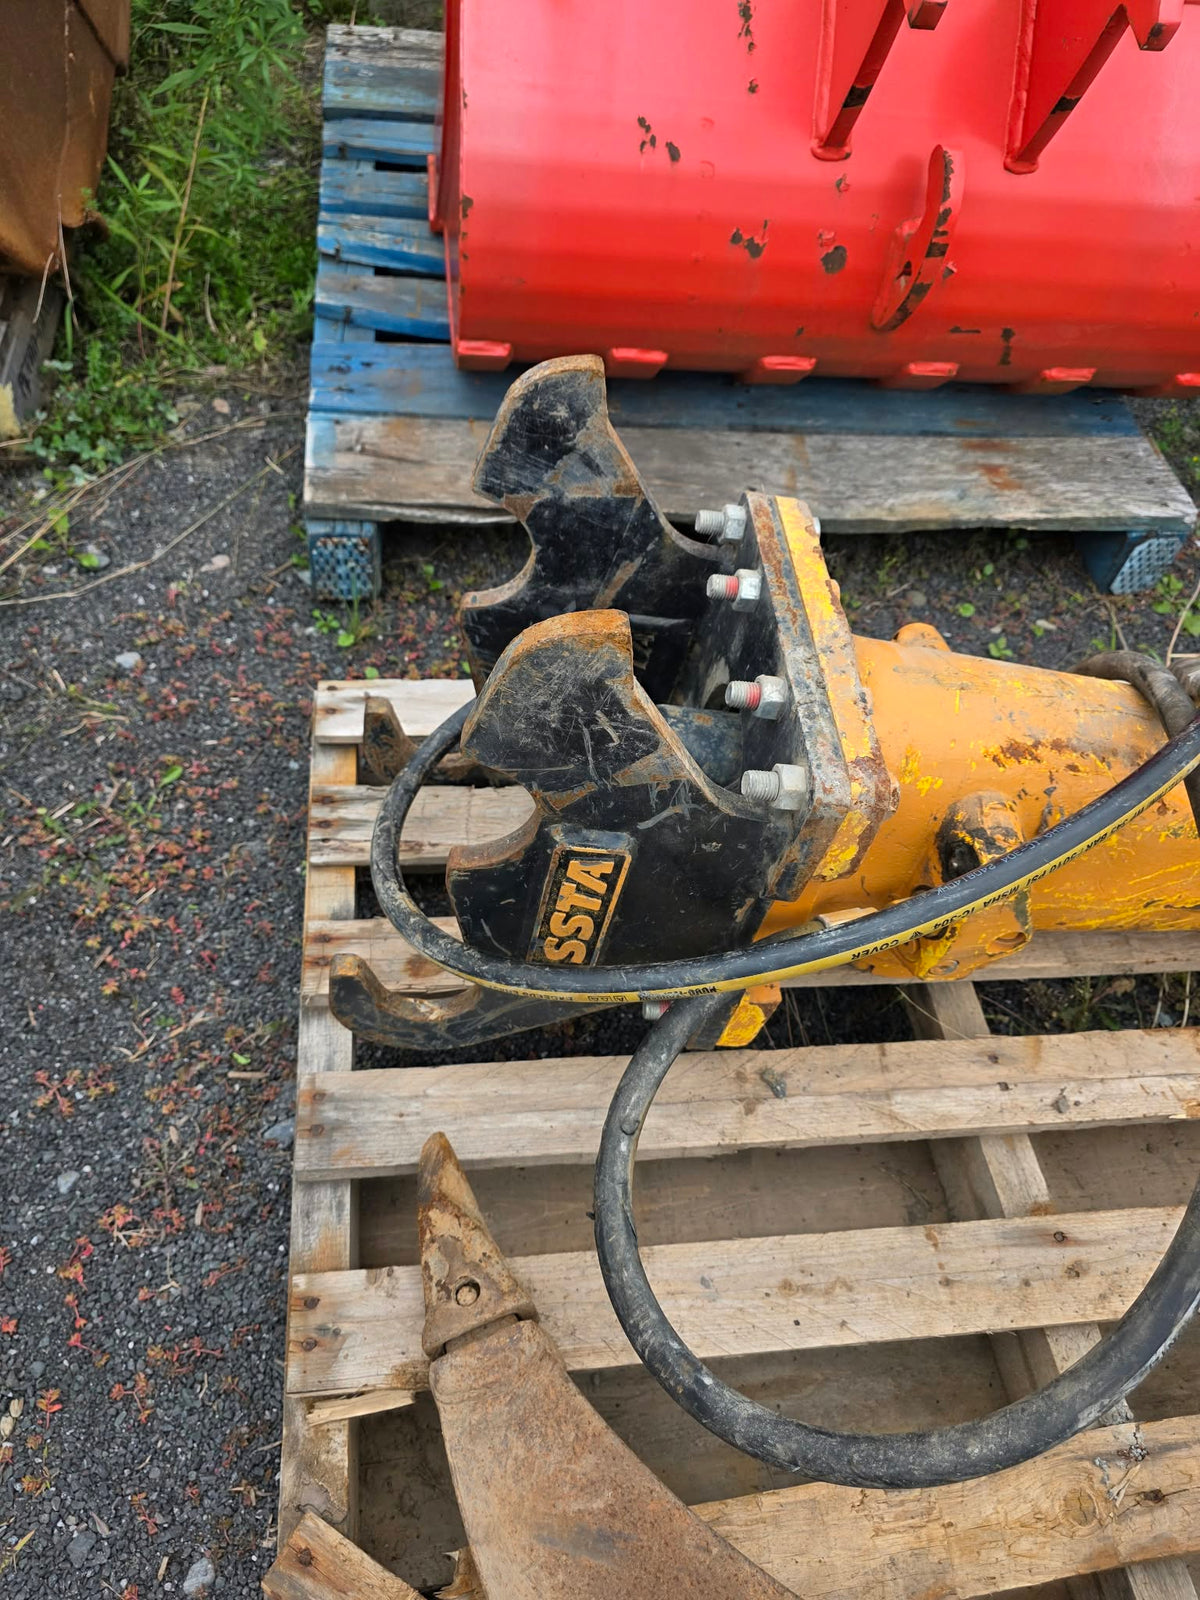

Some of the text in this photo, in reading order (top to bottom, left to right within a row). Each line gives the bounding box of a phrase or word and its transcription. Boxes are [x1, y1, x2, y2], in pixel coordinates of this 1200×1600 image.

[1025, 869, 1047, 887] PSI
[982, 885, 1020, 908] MSHA
[851, 939, 900, 960] COVER
